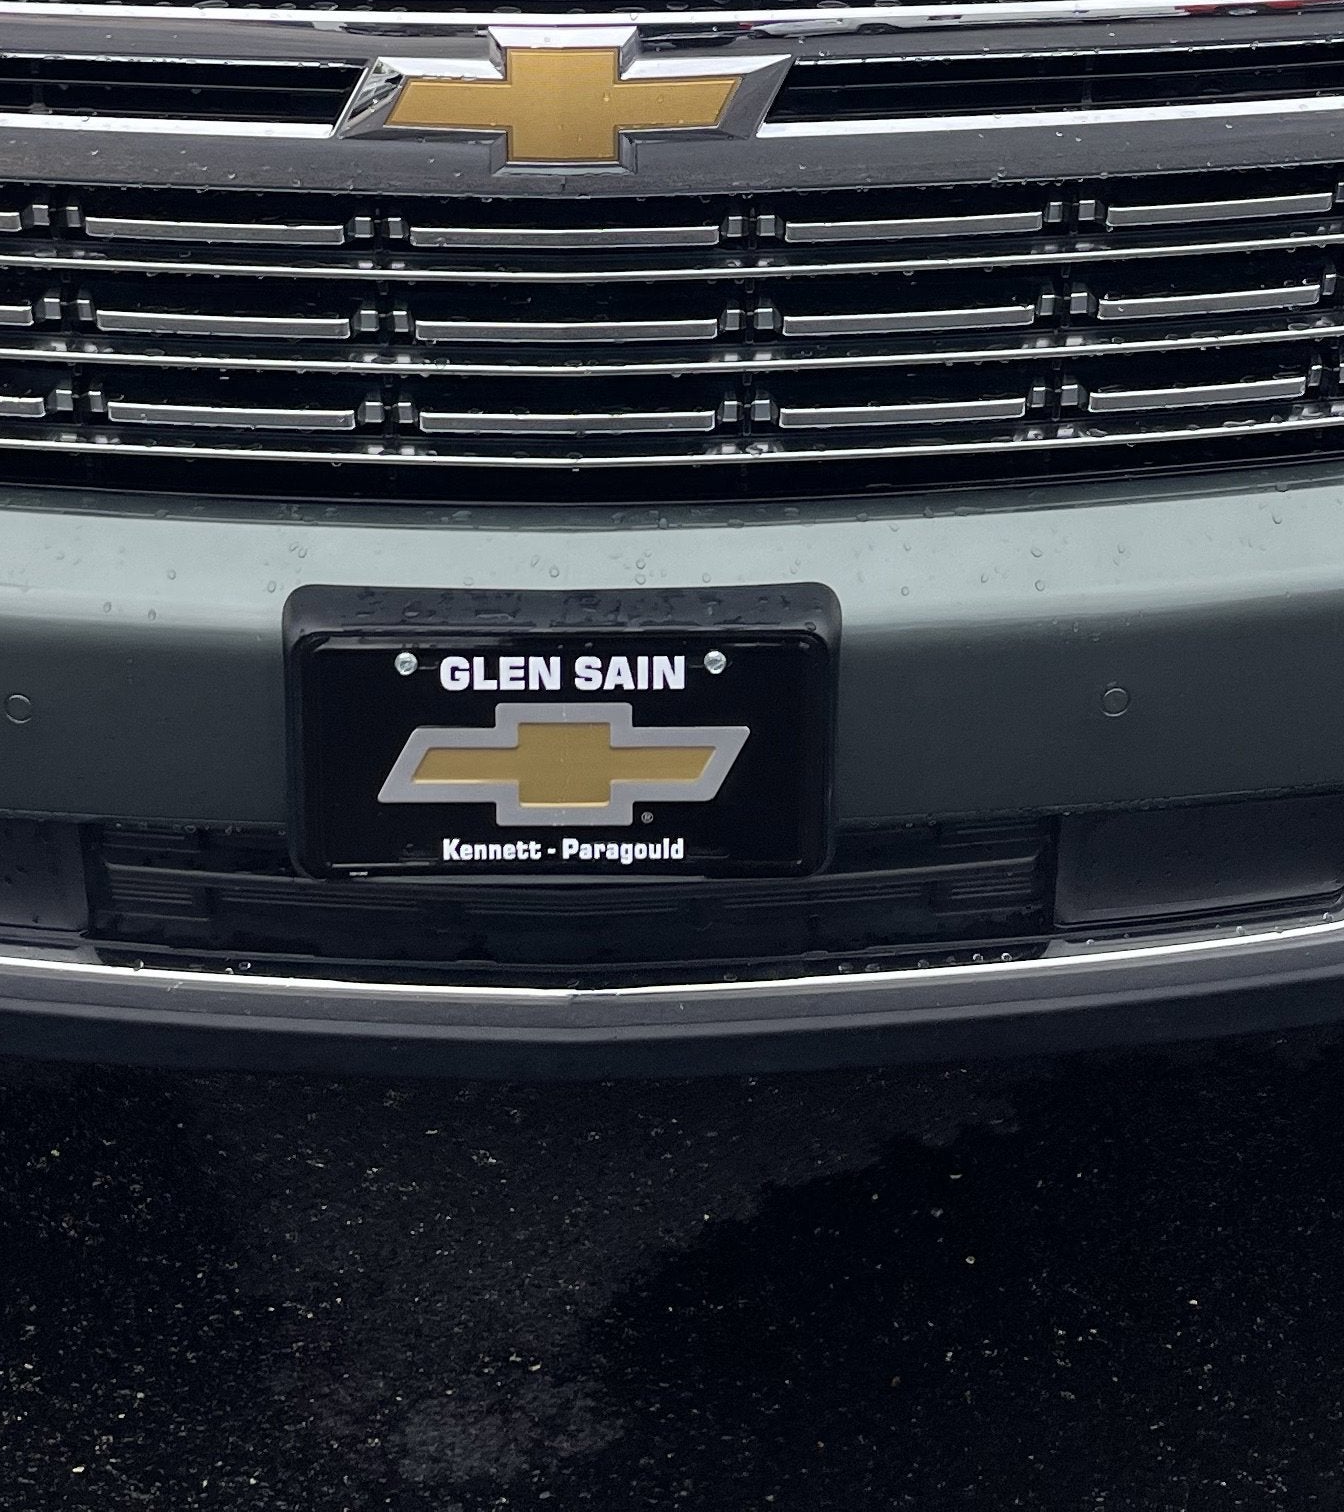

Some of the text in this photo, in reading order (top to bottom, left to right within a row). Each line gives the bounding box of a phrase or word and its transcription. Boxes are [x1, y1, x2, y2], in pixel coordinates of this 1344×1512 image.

[440, 655, 686, 691] GLEN SAIN
[442, 838, 542, 861] Kennett
[562, 838, 685, 864] Paragould
